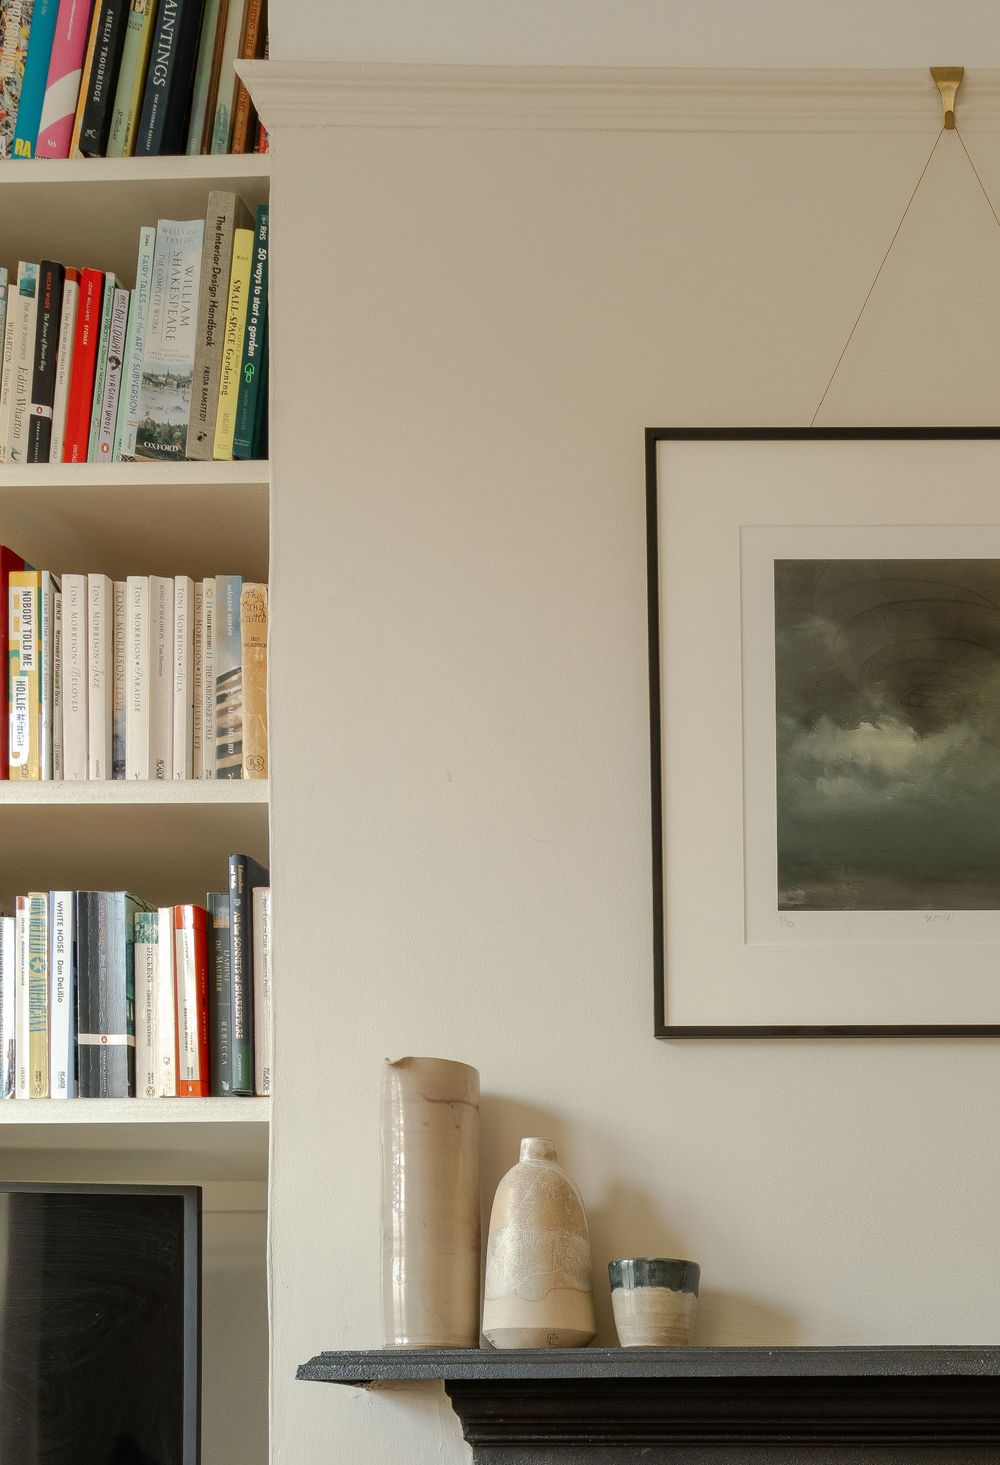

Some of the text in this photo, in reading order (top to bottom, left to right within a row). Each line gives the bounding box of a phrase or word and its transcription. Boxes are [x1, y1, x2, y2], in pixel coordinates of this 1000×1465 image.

[93, 9, 114, 102] AMELIA TROUBRIDGE
[15, 138, 31, 157] RA
[254, 263, 266, 285] ways
[257, 248, 266, 260] 50
[165, 250, 183, 342] SHAKESPEARE
[180, 266, 194, 326] WILLIAM
[205, 216, 225, 347] The Interior Design Handbook
[252, 297, 261, 316] start
[5, 322, 14, 364] WHARTON
[129, 255, 150, 415] FAIRY TALES SUBVERSION
[247, 324, 259, 357] garden
[104, 308, 124, 435] DALLOWAY VIRGINIA WOOLF
[220, 348, 234, 395] Gardening
[14, 366, 28, 438] Edith Wharton
[200, 387, 208, 422] RAMSTEDT
[144, 442, 179, 452] OXFORD
[22, 591, 32, 666] NOBODY TOLD ME
[116, 622, 124, 680] MORRISON
[16, 681, 25, 710] HOLLIE
[57, 978, 65, 1003] DeLillo
[235, 984, 243, 1039] SHAKESPEARE
[220, 1020, 229, 1066] REBECCA
